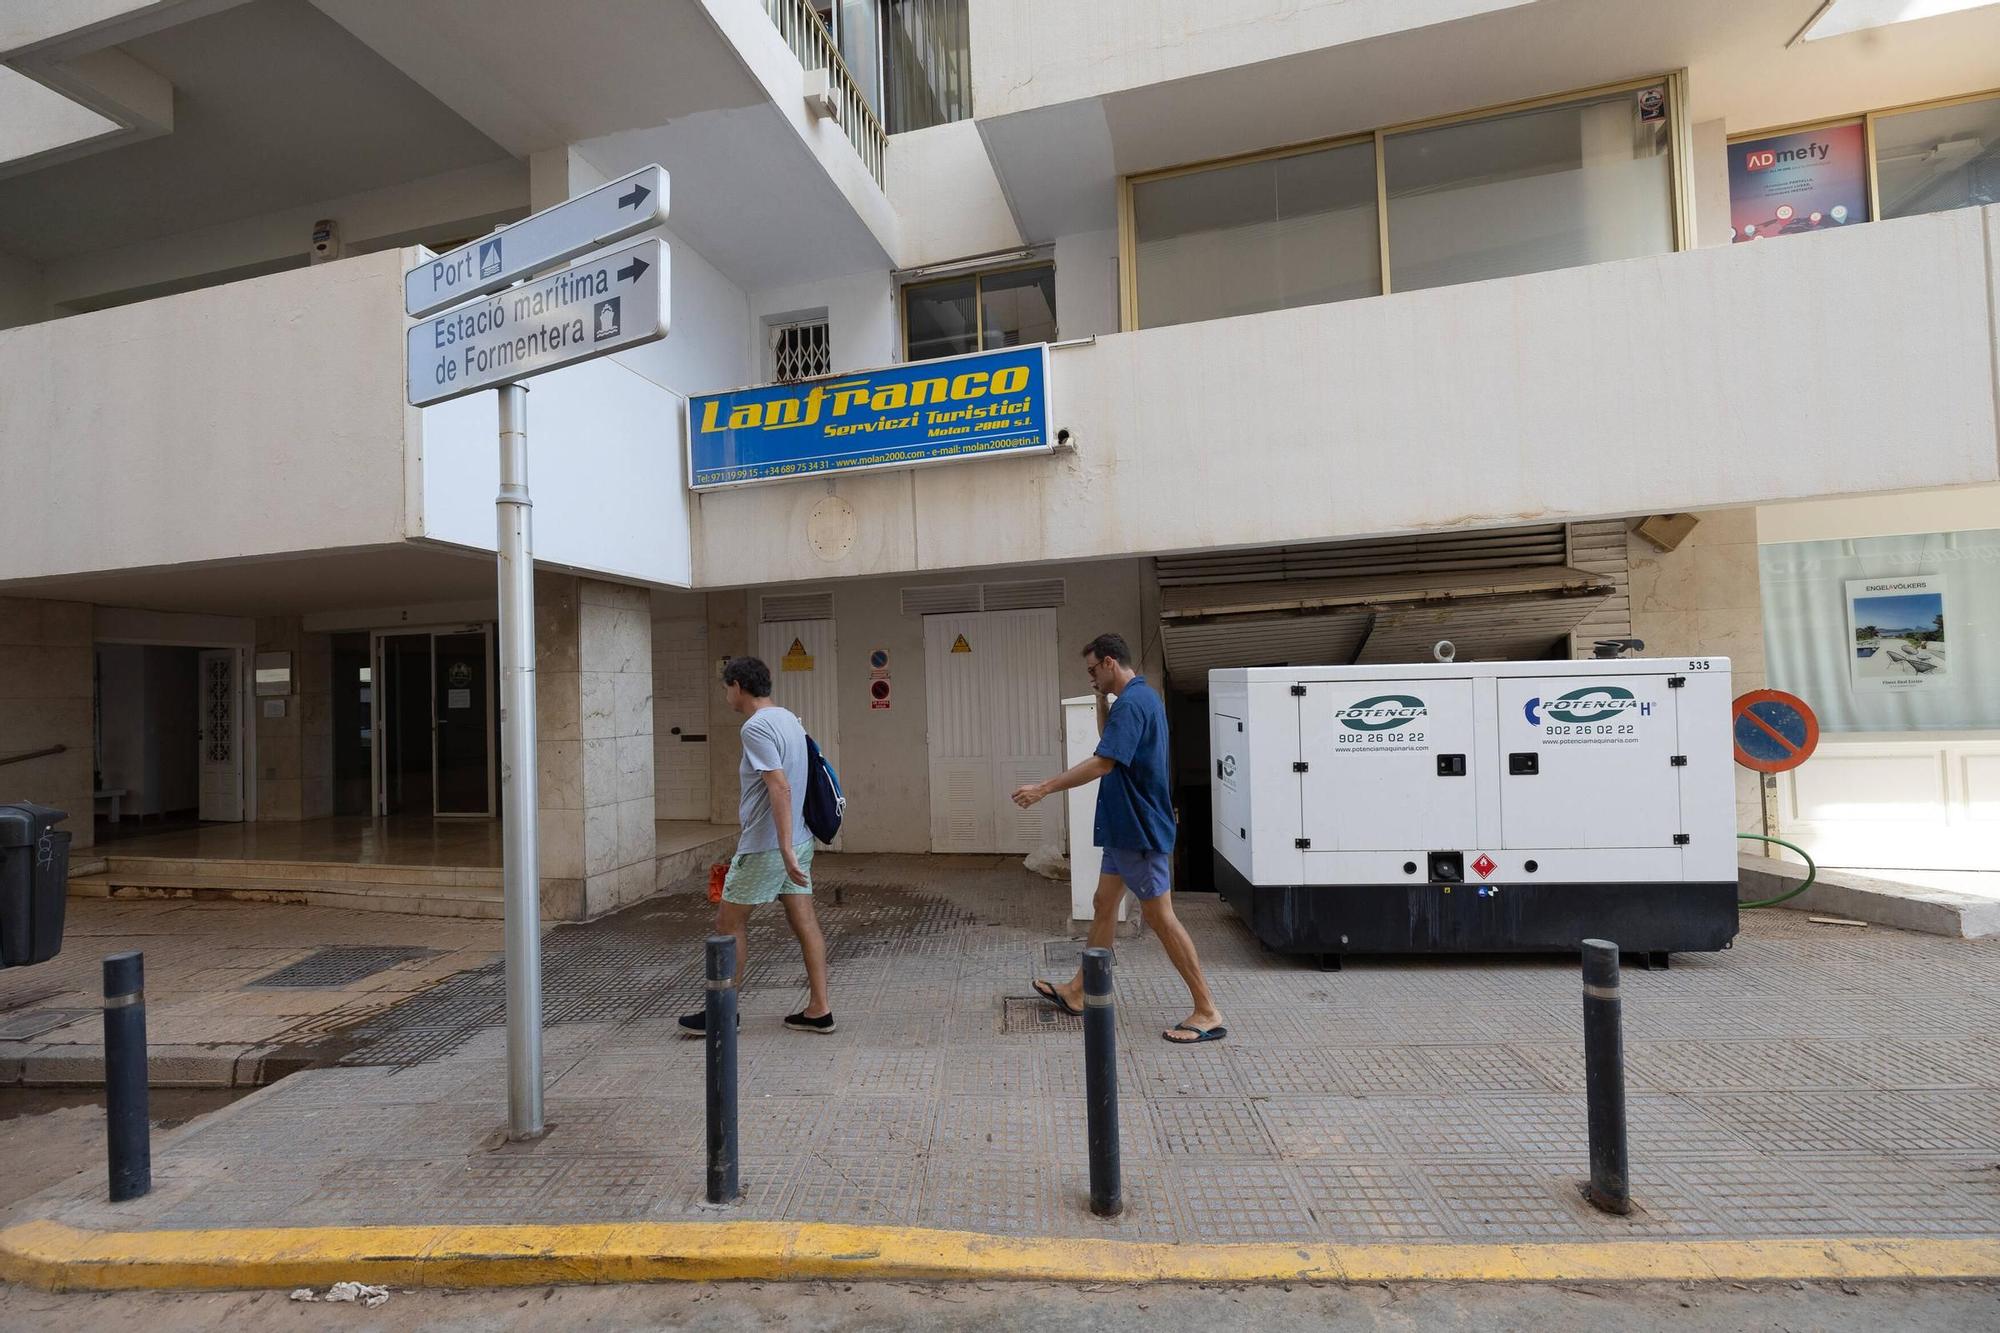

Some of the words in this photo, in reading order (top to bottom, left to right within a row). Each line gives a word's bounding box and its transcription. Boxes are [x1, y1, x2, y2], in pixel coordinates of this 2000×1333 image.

[433, 252, 473, 292] Port
[435, 298, 505, 348] Estació
[513, 269, 610, 322] marítima
[435, 355, 457, 385] de
[465, 318, 585, 376] Formentera
[700, 366, 1031, 434] Lanfranco
[824, 412, 919, 438] Serviczi
[925, 397, 1031, 424] Turistici
[928, 425, 970, 437] Molan
[974, 419, 1010, 431] 2000
[697, 474, 711, 483] Tel:
[711, 472, 725, 481] 971
[727, 471, 736, 480] 19
[737, 470, 747, 479] 99
[749, 469, 758, 478] 15
[765, 467, 780, 476] +34
[781, 465, 796, 474] 689
[797, 463, 807, 472] 75
[808, 462, 819, 471] 34
[820, 461, 829, 469] 31
[836, 449, 925, 467] www.molan2000.com
[932, 445, 961, 457] e-mail:
[962, 435, 1040, 453] molan2000@tin.it
[1689, 661, 1710, 670] 535
[1335, 709, 1428, 718] POTENCIA
[1542, 700, 1638, 709] POTENCIA
[1339, 734, 1363, 743] 902
[1368, 733, 1384, 742] 26
[1388, 733, 1404, 742] 02
[1409, 732, 1425, 741] 22
[1546, 726, 1571, 735] 902
[1576, 725, 1592, 734] 26
[1596, 725, 1613, 734] 02
[1618, 725, 1634, 734] 22
[1335, 745, 1429, 753] www.potenciamaquinaria.com
